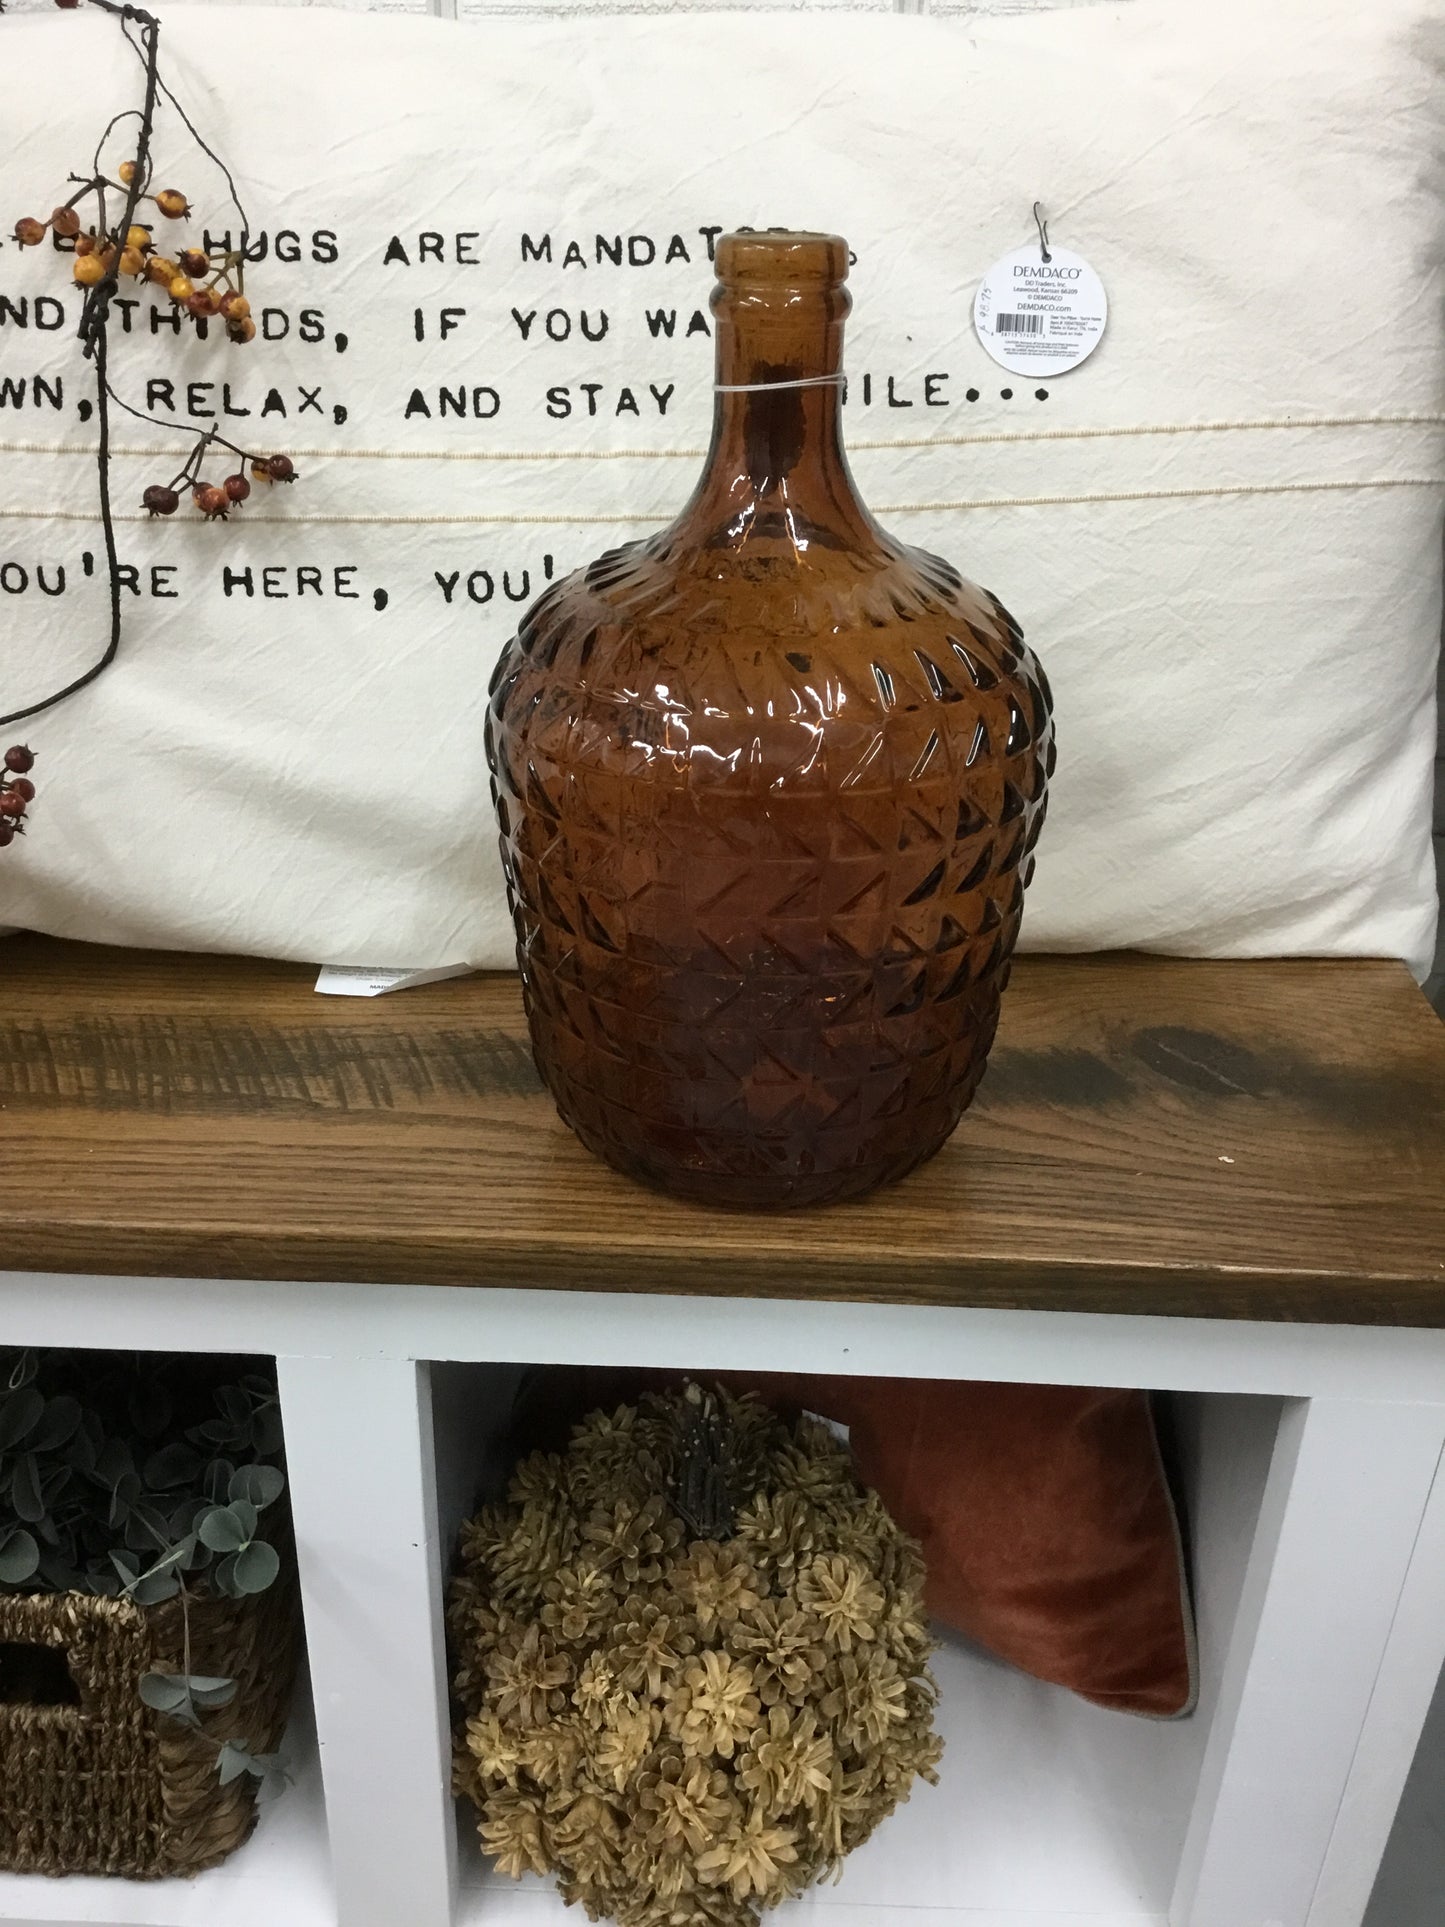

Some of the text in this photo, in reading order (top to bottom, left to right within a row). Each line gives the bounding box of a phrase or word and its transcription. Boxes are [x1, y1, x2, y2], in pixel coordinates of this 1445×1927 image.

[203, 226, 788, 269] HUGS ARE MANDAT
[113, 299, 348, 353] THIDS,
[414, 307, 466, 342] IF
[511, 307, 609, 342] YOU
[1017, 302, 1072, 312] DEMDACO.com
[147, 378, 348, 425] RELAX,
[404, 385, 501, 419] AND
[546, 383, 675, 419] STAY
[223, 566, 389, 611] HERE,
